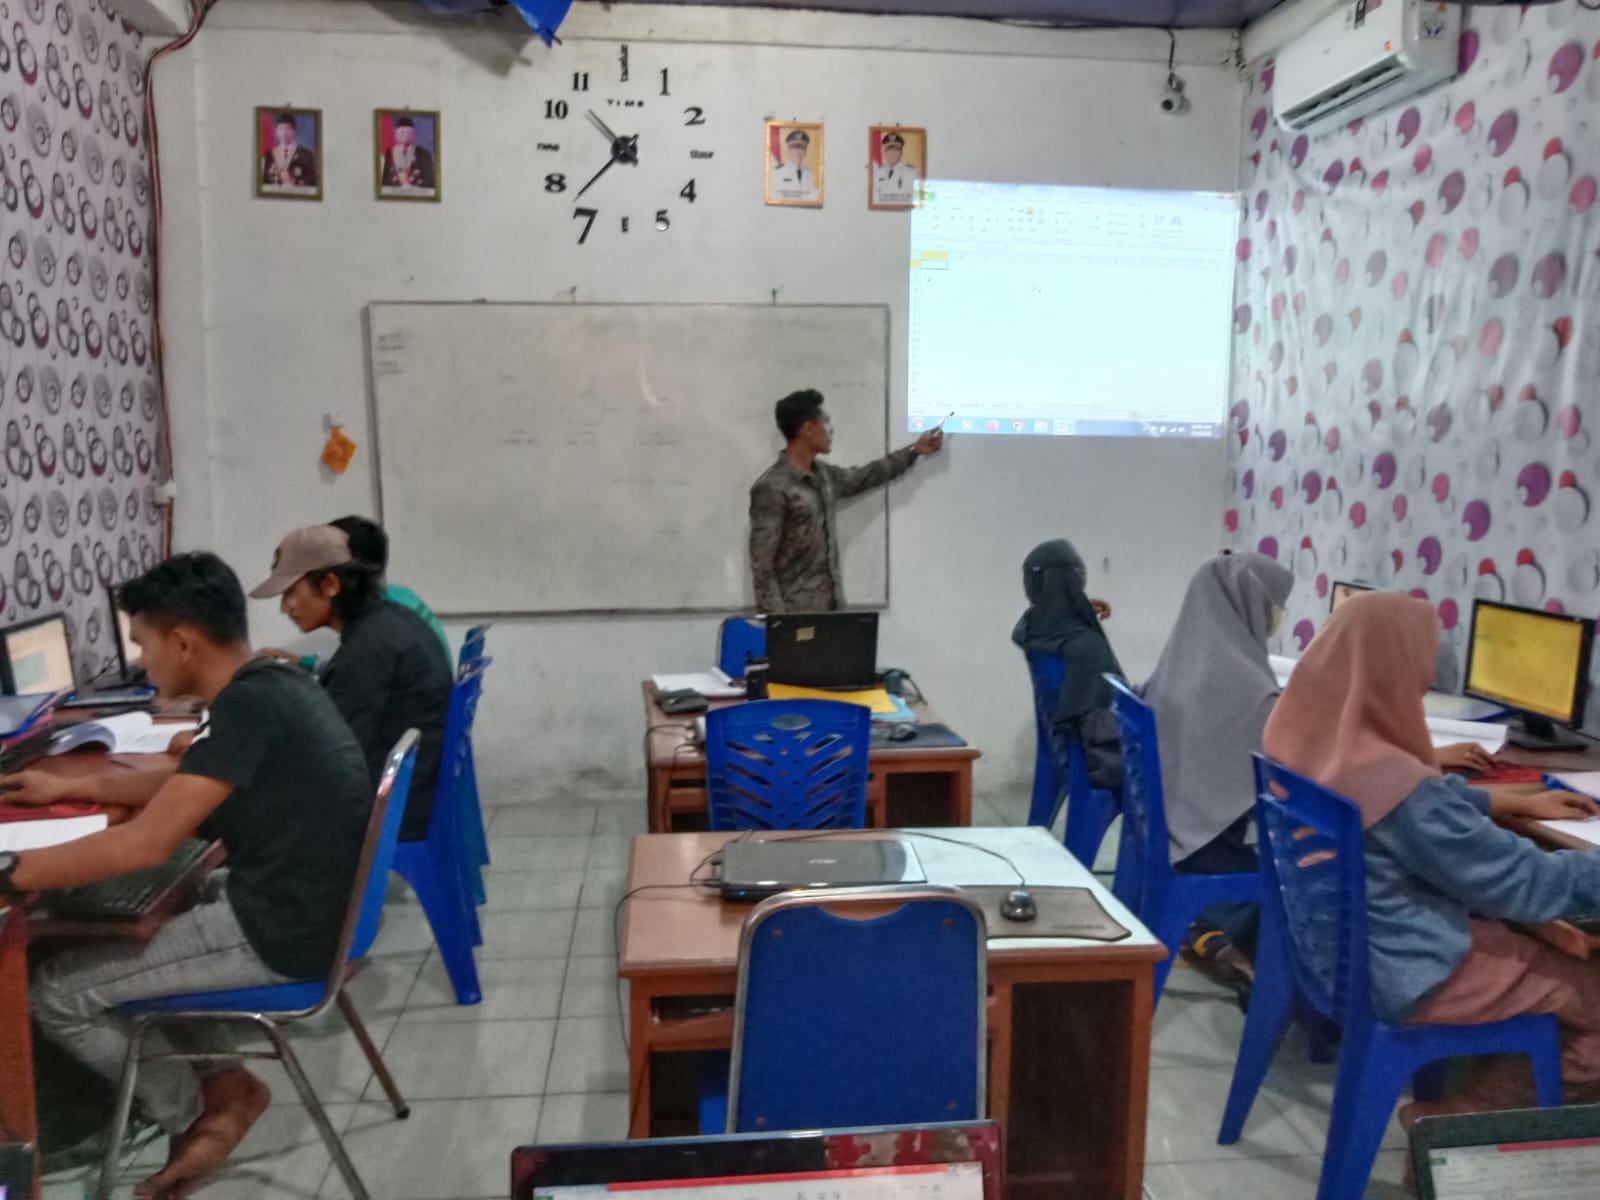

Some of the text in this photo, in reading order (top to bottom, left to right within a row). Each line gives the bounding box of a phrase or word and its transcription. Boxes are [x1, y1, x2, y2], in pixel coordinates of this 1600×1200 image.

[572, 72, 590, 92] 11
[659, 67, 671, 96] 1
[544, 99, 568, 120] 10
[684, 106, 706, 126] 2
[544, 173, 567, 194] 8
[679, 178, 697, 203] 4
[572, 207, 598, 245] 7
[655, 209, 670, 232] 5
